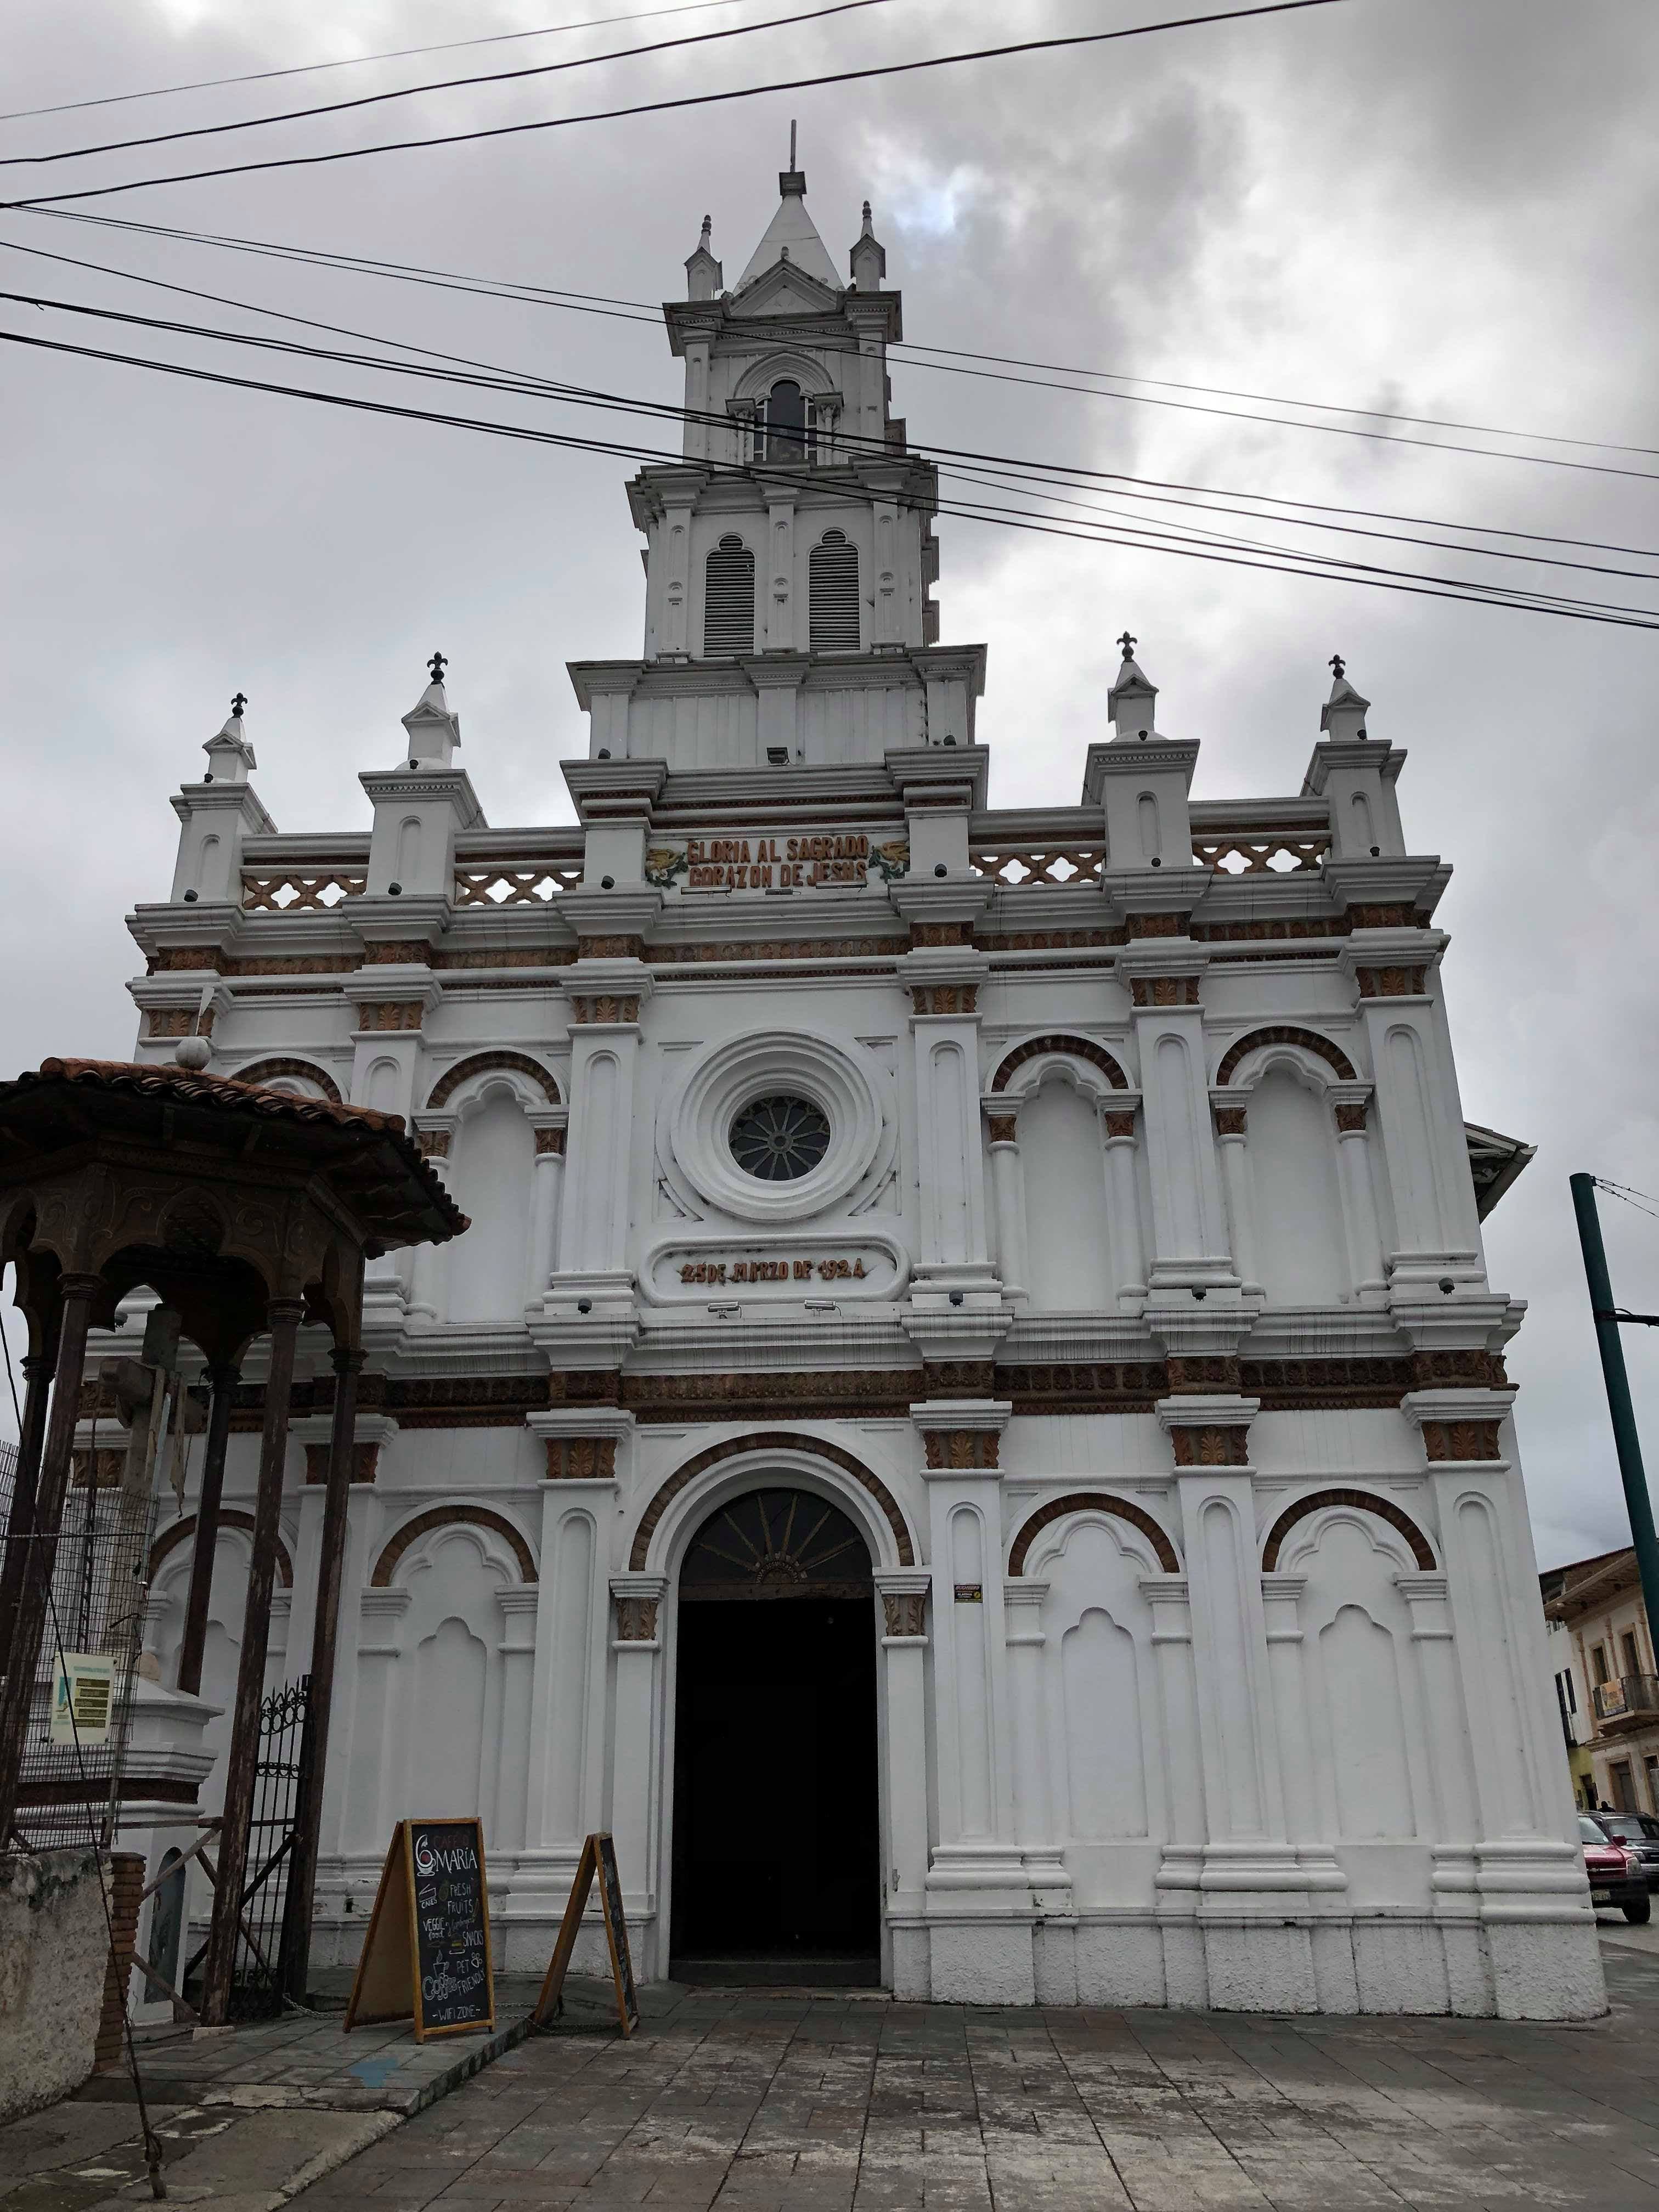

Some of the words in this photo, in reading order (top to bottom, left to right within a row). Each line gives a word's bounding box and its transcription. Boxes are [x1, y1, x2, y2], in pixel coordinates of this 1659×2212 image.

[687, 840, 751, 865] GLORIA
[757, 839, 781, 863] AL
[787, 835, 869, 861] SAGRADO
[689, 865, 772, 889] CORAZON
[780, 864, 804, 887] DE
[807, 861, 867, 887] JESUS
[681, 1263, 706, 1283] 25
[708, 1264, 726, 1283] DE
[733, 1261, 788, 1283] MARZO
[793, 1261, 812, 1279] DE
[818, 1257, 865, 1280] 1924
[448, 1899, 473, 1915] FRUITS
[423, 1917, 445, 1931] VEGGIE
[462, 1930, 483, 1947] SNACKS
[456, 1959, 469, 1973] PET
[457, 1967, 486, 1996] FRIENDLY
[438, 2008, 455, 2021] WIFI
[457, 2005, 476, 2019] ZONE
